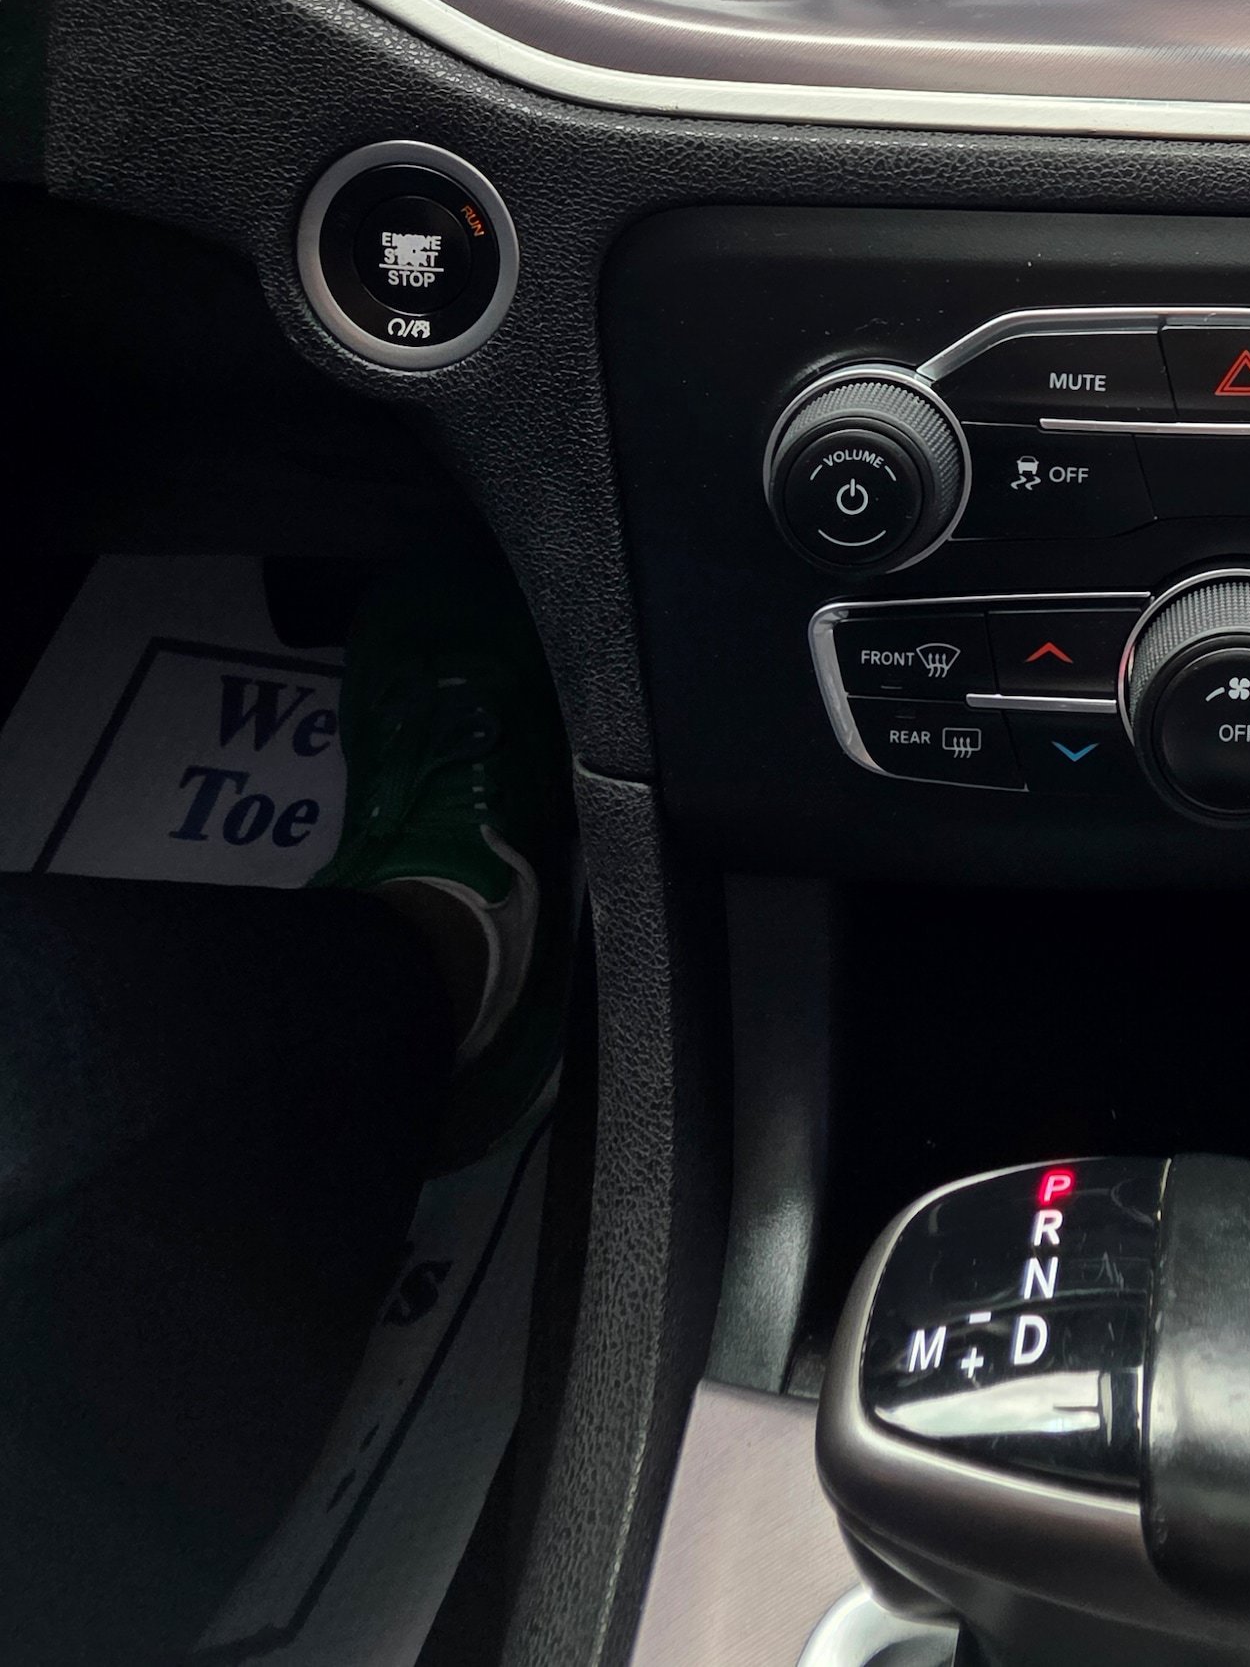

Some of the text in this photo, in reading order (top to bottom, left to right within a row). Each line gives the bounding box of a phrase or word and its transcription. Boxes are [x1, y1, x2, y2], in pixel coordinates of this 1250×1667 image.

[460, 204, 486, 237] RUN
[387, 269, 436, 288] STOP
[1049, 372, 1107, 392] MUTE
[822, 448, 885, 469] VOLUME
[1049, 466, 1090, 483] OFF
[861, 649, 915, 666] FRONT
[219, 675, 338, 757] We
[889, 729, 931, 745] REAR
[169, 764, 320, 847] Toe
[1043, 1173, 1072, 1203] P
[1034, 1209, 1063, 1247] R
[1024, 1256, 1059, 1300] N
[908, 1325, 947, 1373] M
[1013, 1314, 1049, 1366] D
